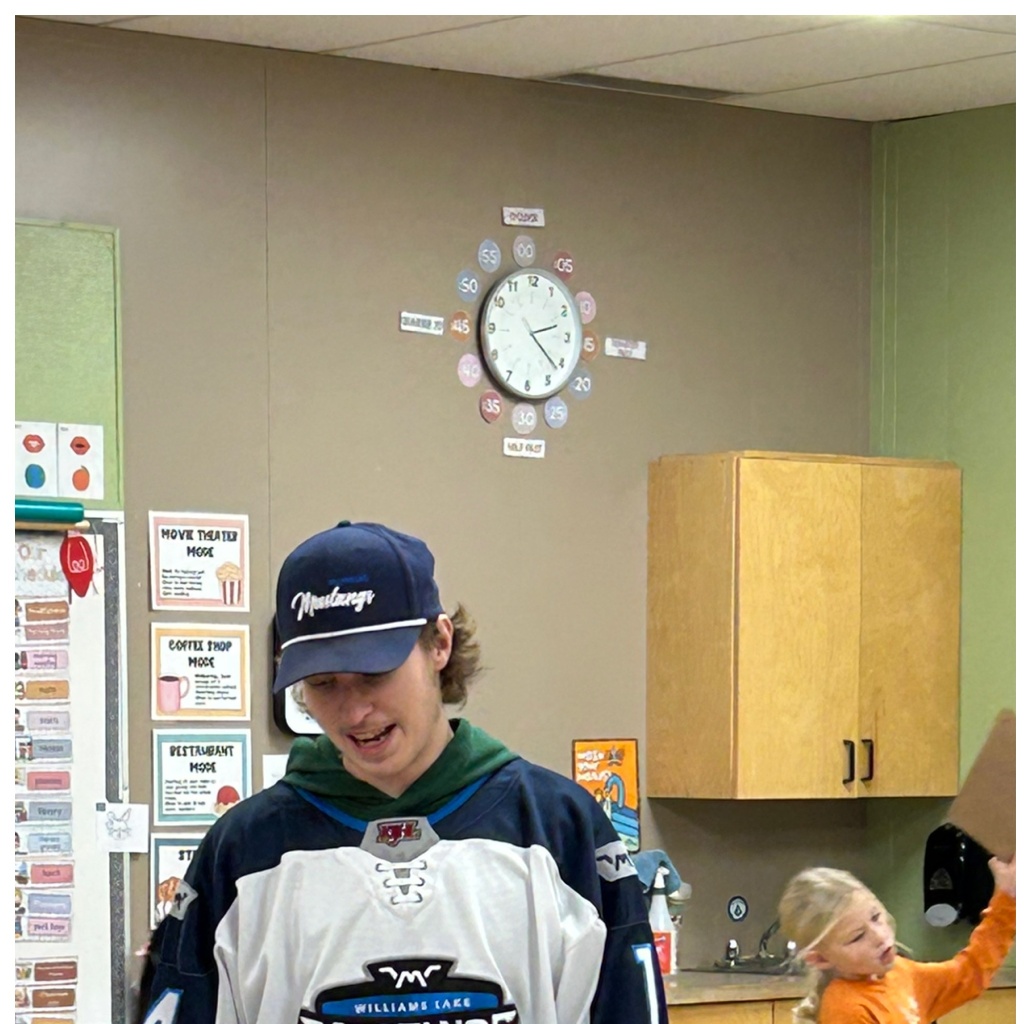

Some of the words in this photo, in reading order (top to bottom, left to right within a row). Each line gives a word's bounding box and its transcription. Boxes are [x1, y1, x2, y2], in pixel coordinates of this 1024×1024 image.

[527, 275, 539, 288] 12
[488, 323, 496, 334] 9
[506, 370, 513, 382] 7
[545, 375, 551, 386] 5
[524, 380, 531, 391] 6
[291, 586, 376, 621] Mustangs
[354, 1001, 427, 1014] WILLIAMS
[435, 997, 471, 1010] LAKE
